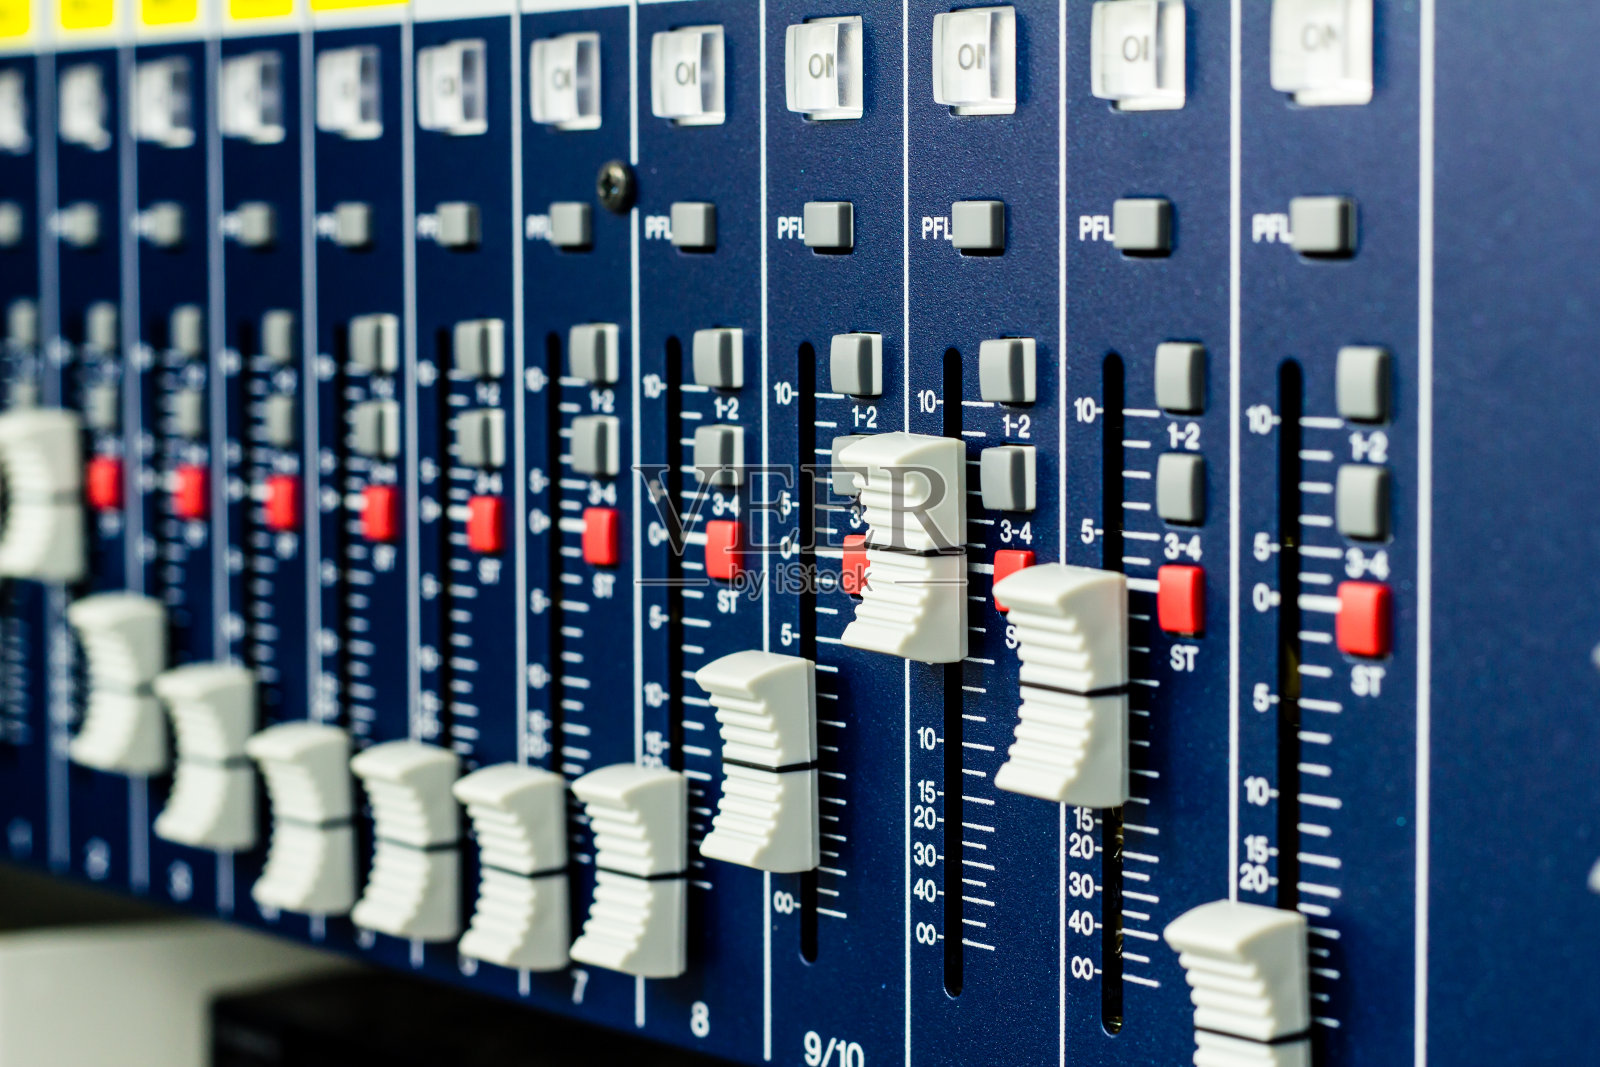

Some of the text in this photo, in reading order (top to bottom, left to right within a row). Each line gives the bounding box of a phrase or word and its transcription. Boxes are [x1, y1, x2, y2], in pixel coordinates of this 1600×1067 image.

[922, 217, 953, 240] PFL
[1078, 215, 1115, 242] PFL
[643, 374, 661, 399] 10
[774, 382, 792, 405] 10
[714, 397, 739, 420] 1-2
[917, 390, 936, 413] 10
[1074, 397, 1096, 423] 10
[851, 405, 877, 428] 1-2
[1002, 414, 1031, 438] 1-2
[1246, 404, 1272, 435] 10
[1167, 422, 1200, 450] 1-2
[1350, 431, 1388, 464] 1-2
[712, 492, 740, 516] 3-4
[780, 493, 792, 515] 5
[648, 522, 661, 546] 0
[1000, 519, 1032, 545] 3-4
[1081, 518, 1096, 544] 5
[780, 536, 792, 560] 0
[1164, 532, 1202, 561] 3-4
[1253, 532, 1270, 562] 5
[1345, 547, 1390, 580] 3-4
[717, 588, 739, 614] ST
[1253, 582, 1270, 612] 0
[649, 604, 662, 630] 5
[780, 623, 792, 646] 5
[1005, 625, 1019, 649] S
[1170, 644, 1199, 672] ST
[1351, 664, 1386, 696] ST
[644, 682, 663, 708] 10
[1253, 683, 1270, 712] 5
[917, 727, 936, 750] 10
[917, 780, 936, 803] 15
[1244, 776, 1270, 806] 10
[914, 805, 936, 830] 20
[1073, 806, 1094, 832] 15
[914, 842, 936, 867] 30
[1069, 833, 1094, 860] 20
[1244, 835, 1269, 864] 15
[913, 878, 936, 903] 40
[1069, 871, 1094, 899] 30
[1239, 862, 1269, 893] 20
[1068, 909, 1094, 936] 40
[571, 969, 589, 1004] 7
[690, 1001, 710, 1038] 8
[804, 1030, 864, 1067] 9/10
